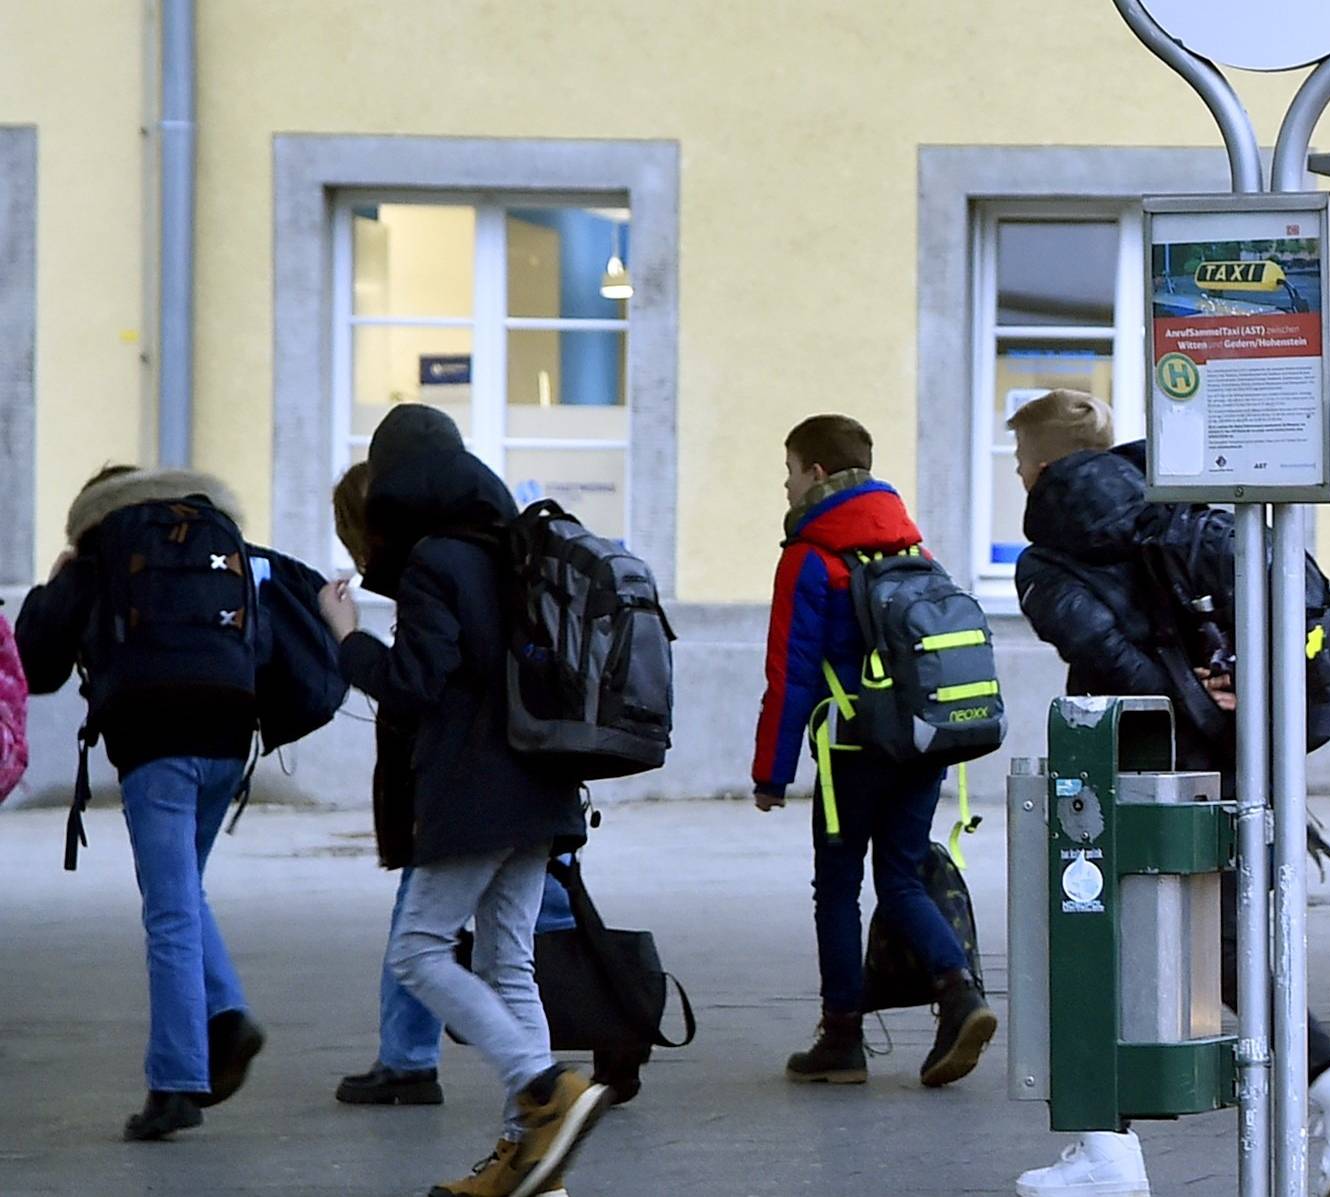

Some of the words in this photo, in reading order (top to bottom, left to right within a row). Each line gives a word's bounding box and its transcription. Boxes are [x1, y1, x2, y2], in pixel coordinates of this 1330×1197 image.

[1205, 264, 1256, 281] TAXI
[1165, 326, 1240, 338] AnrufSammelTaxi
[1241, 324, 1265, 337] (AST)
[1177, 340, 1208, 350] Witten
[1168, 363, 1191, 387] H
[1254, 462, 1268, 470] AST
